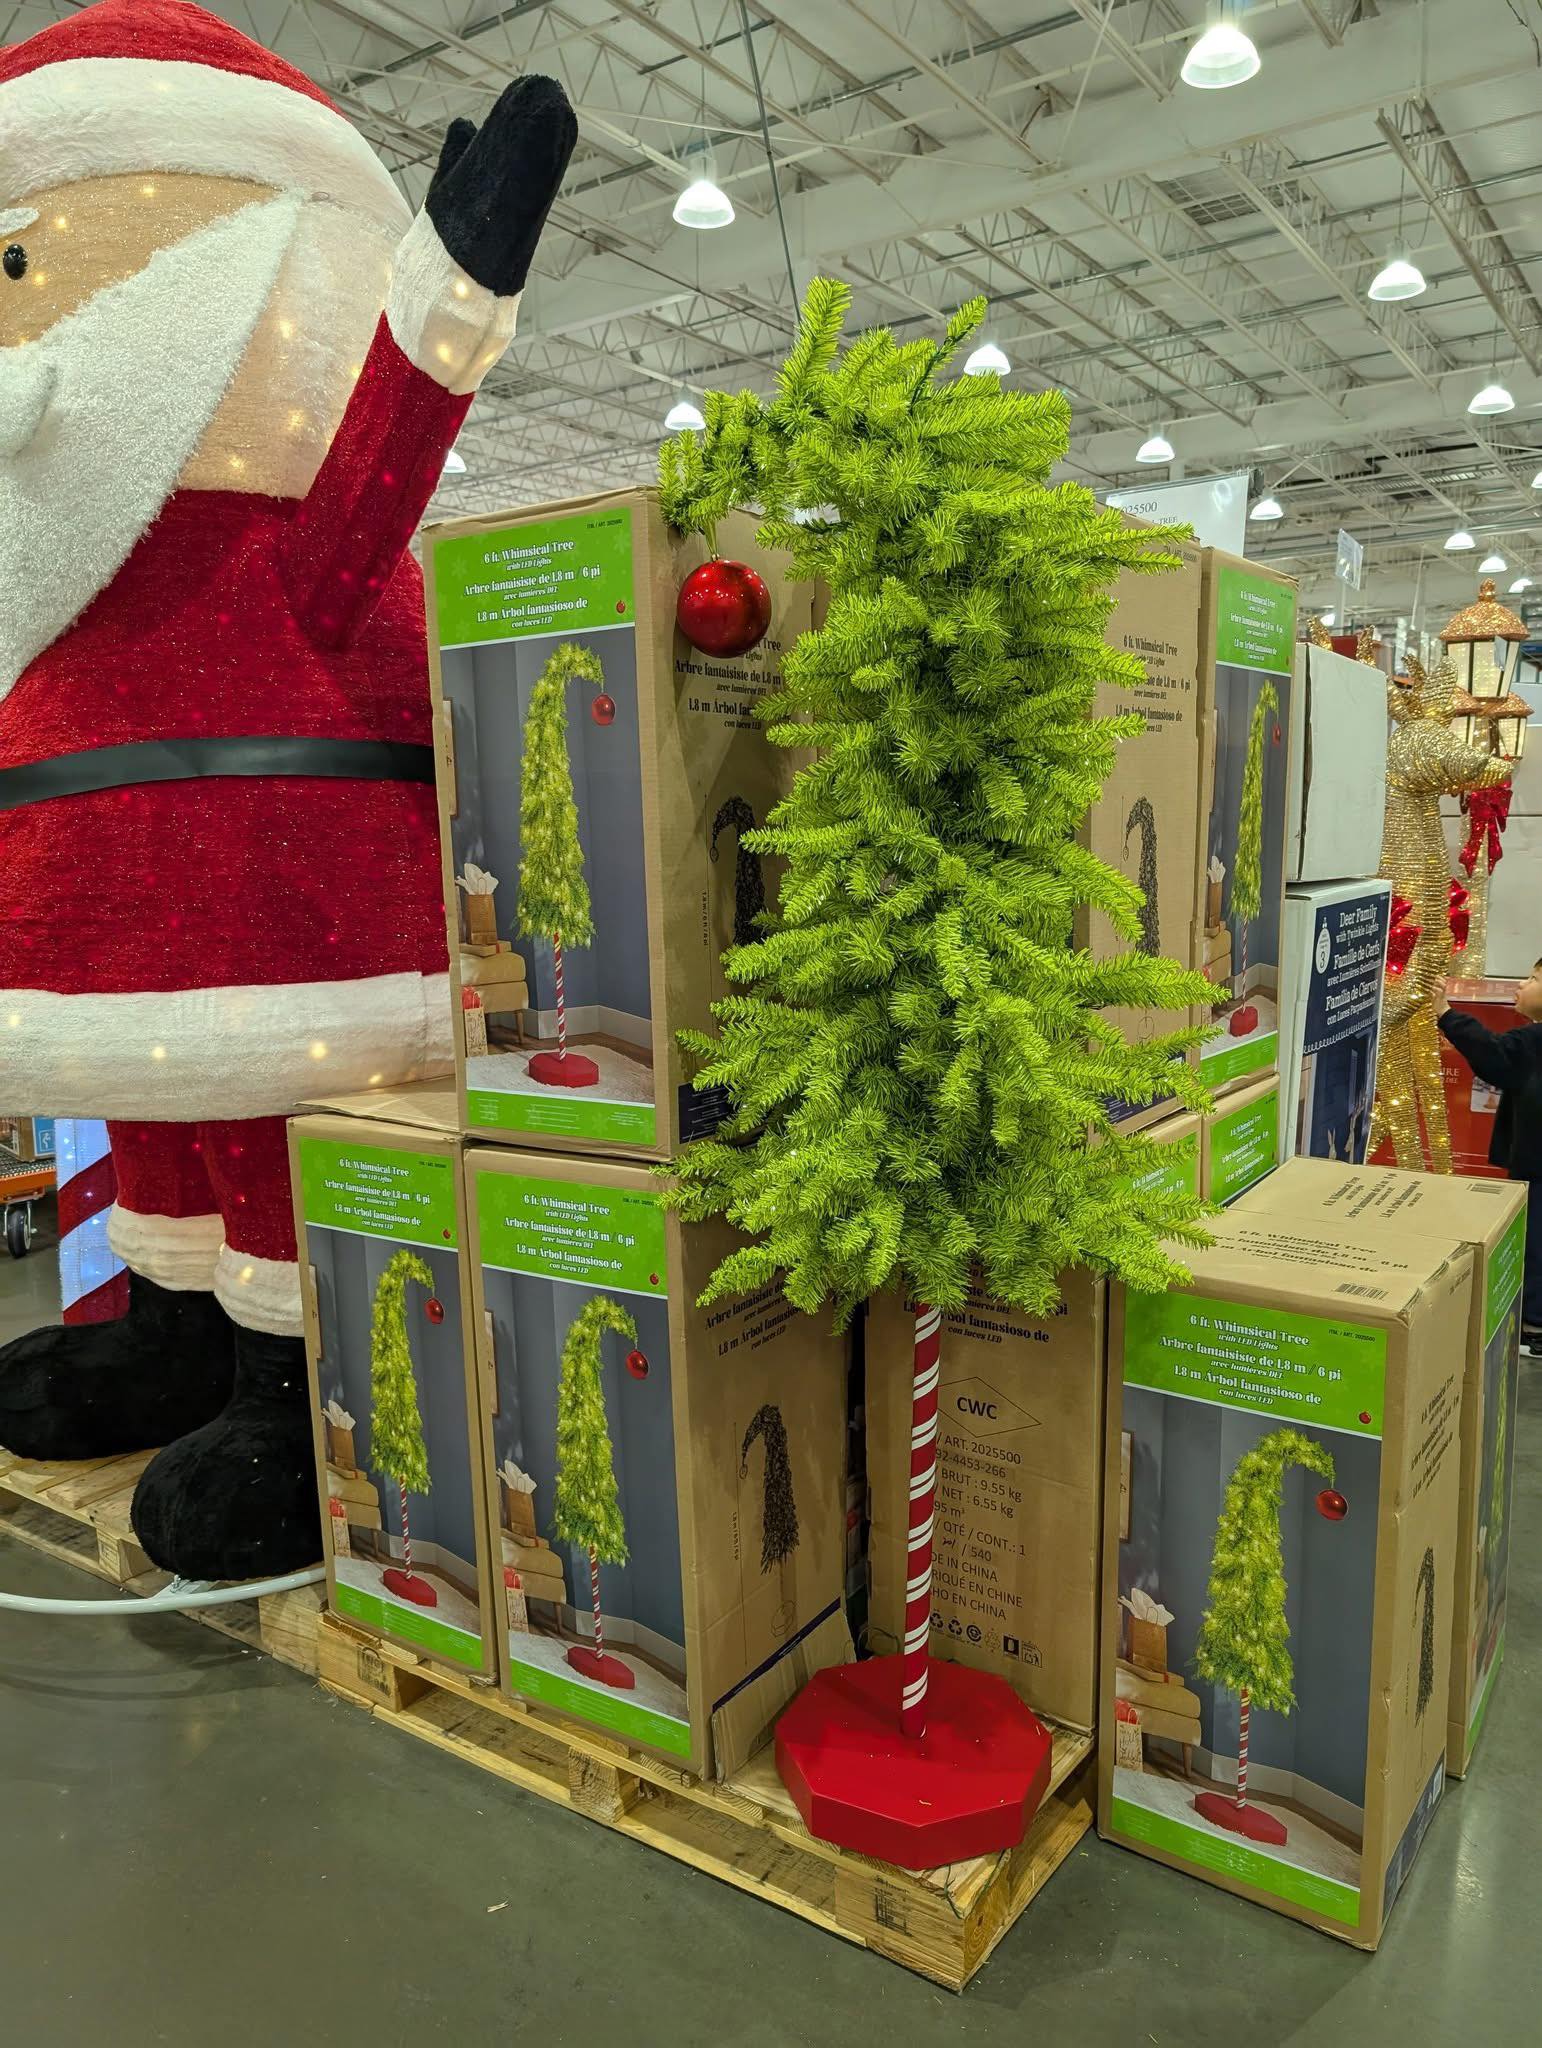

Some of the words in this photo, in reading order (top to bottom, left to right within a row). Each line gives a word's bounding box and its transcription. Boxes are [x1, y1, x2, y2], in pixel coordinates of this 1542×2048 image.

[484, 554, 489, 564] 6
[490, 551, 500, 562] ft.
[502, 543, 549, 561] Whimsical
[552, 540, 574, 552] Tree
[533, 558, 552, 568] Lights
[464, 582, 490, 596] Arbre
[491, 576, 537, 592] fantaisiste
[539, 573, 550, 584] de
[565, 570, 574, 580] m
[583, 567, 589, 578] 6
[591, 564, 601, 579] pi
[489, 610, 498, 620] m
[527, 599, 574, 615] fantasioso
[576, 597, 588, 609] de
[763, 638, 781, 652] Tree
[1136, 637, 1164, 653] Whimsical
[1165, 643, 1177, 656] Tree
[675, 660, 702, 675] Arbre
[705, 662, 748, 681] fantaisiste
[751, 670, 760, 683] de
[773, 674, 781, 685] m
[702, 702, 710, 712] m
[1340, 911, 1355, 927] Deer
[1356, 904, 1377, 923] Family
[1336, 931, 1346, 943] with
[1348, 926, 1365, 947] Twinkle
[1366, 923, 1379, 936] Lights
[1333, 949, 1357, 970] Famille
[1358, 946, 1365, 961] de
[1327, 976, 1339, 987] avec
[1325, 988, 1350, 1011] Familia
[1351, 985, 1358, 1000] de
[1359, 979, 1378, 997] Ciervos
[1327, 1014, 1336, 1025] con
[353, 1161, 391, 1174] Whimsical
[392, 1166, 409, 1177] Tree
[324, 1179, 344, 1190] Arbre
[345, 1182, 381, 1195] fantaisiste
[382, 1188, 391, 1197] de
[524, 1194, 529, 1204] 6
[530, 1195, 539, 1206] ft.
[541, 1196, 586, 1212] Whimsical
[588, 1203, 610, 1215] Tree
[373, 1209, 410, 1224] fantasioso
[411, 1216, 421, 1226] de
[504, 1217, 529, 1229] Arbre
[530, 1220, 573, 1236] fantaisiste
[575, 1227, 586, 1238] de
[600, 1233, 610, 1242] m
[618, 1234, 624, 1244] 6
[625, 1235, 635, 1247] pi
[527, 1246, 536, 1256] m
[564, 1251, 609, 1267] fantasioso
[611, 1259, 623, 1270] de
[705, 1306, 732, 1330] Arbre
[970, 1314, 1031, 1339] fantasioso
[1034, 1329, 1049, 1343] de
[948, 1326, 962, 1335] con
[964, 1328, 986, 1340] luces
[987, 1334, 1002, 1344] LED
[1190, 1314, 1197, 1326] 6
[1199, 1316, 1211, 1328] ft.
[1214, 1319, 1277, 1340] Whimsical
[1279, 1331, 1309, 1347] Tree
[1217, 1333, 1236, 1344] with
[1237, 1335, 1251, 1347] LED
[1252, 1338, 1279, 1352] Lights
[730, 1338, 739, 1349] m
[1160, 1335, 1194, 1352] Arbre
[1197, 1342, 1256, 1364] fantaisiste
[1258, 1354, 1274, 1368] de
[1277, 1357, 1291, 1372] 1.8
[1294, 1363, 1306, 1374] m
[1318, 1366, 1325, 1378] 6
[1328, 1368, 1341, 1382] pi
[1211, 1359, 1229, 1370] avec
[1174, 1364, 1188, 1379] 1.8
[1190, 1369, 1202, 1381] m
[1240, 1379, 1303, 1402] fantasioso
[1305, 1390, 1322, 1405] de
[1219, 1386, 1235, 1397] con
[1235, 1389, 1258, 1402] luces
[957, 1396, 997, 1420] CWC
[944, 1436, 968, 1451] ART.
[971, 1441, 1022, 1465] 2025500
[941, 1467, 972, 1486] BRUT
[980, 1479, 1006, 1497] 9.55
[1008, 1485, 1022, 1503] kg
[942, 1484, 963, 1501] NET
[973, 1496, 997, 1511] 6.55
[1000, 1502, 1014, 1519] kg
[943, 1521, 965, 1536] QTÉ
[971, 1546, 992, 1561] 540
[932, 1552, 943, 1564] DE
[947, 1557, 958, 1568] IN
[962, 1562, 997, 1582] CHINA
[932, 1569, 965, 1589] RIQUÉ
[969, 1582, 983, 1594] EN
[988, 1588, 1023, 1608] CHINE
[952, 1593, 966, 1606] EN
[970, 1600, 1006, 1620] CHINA
